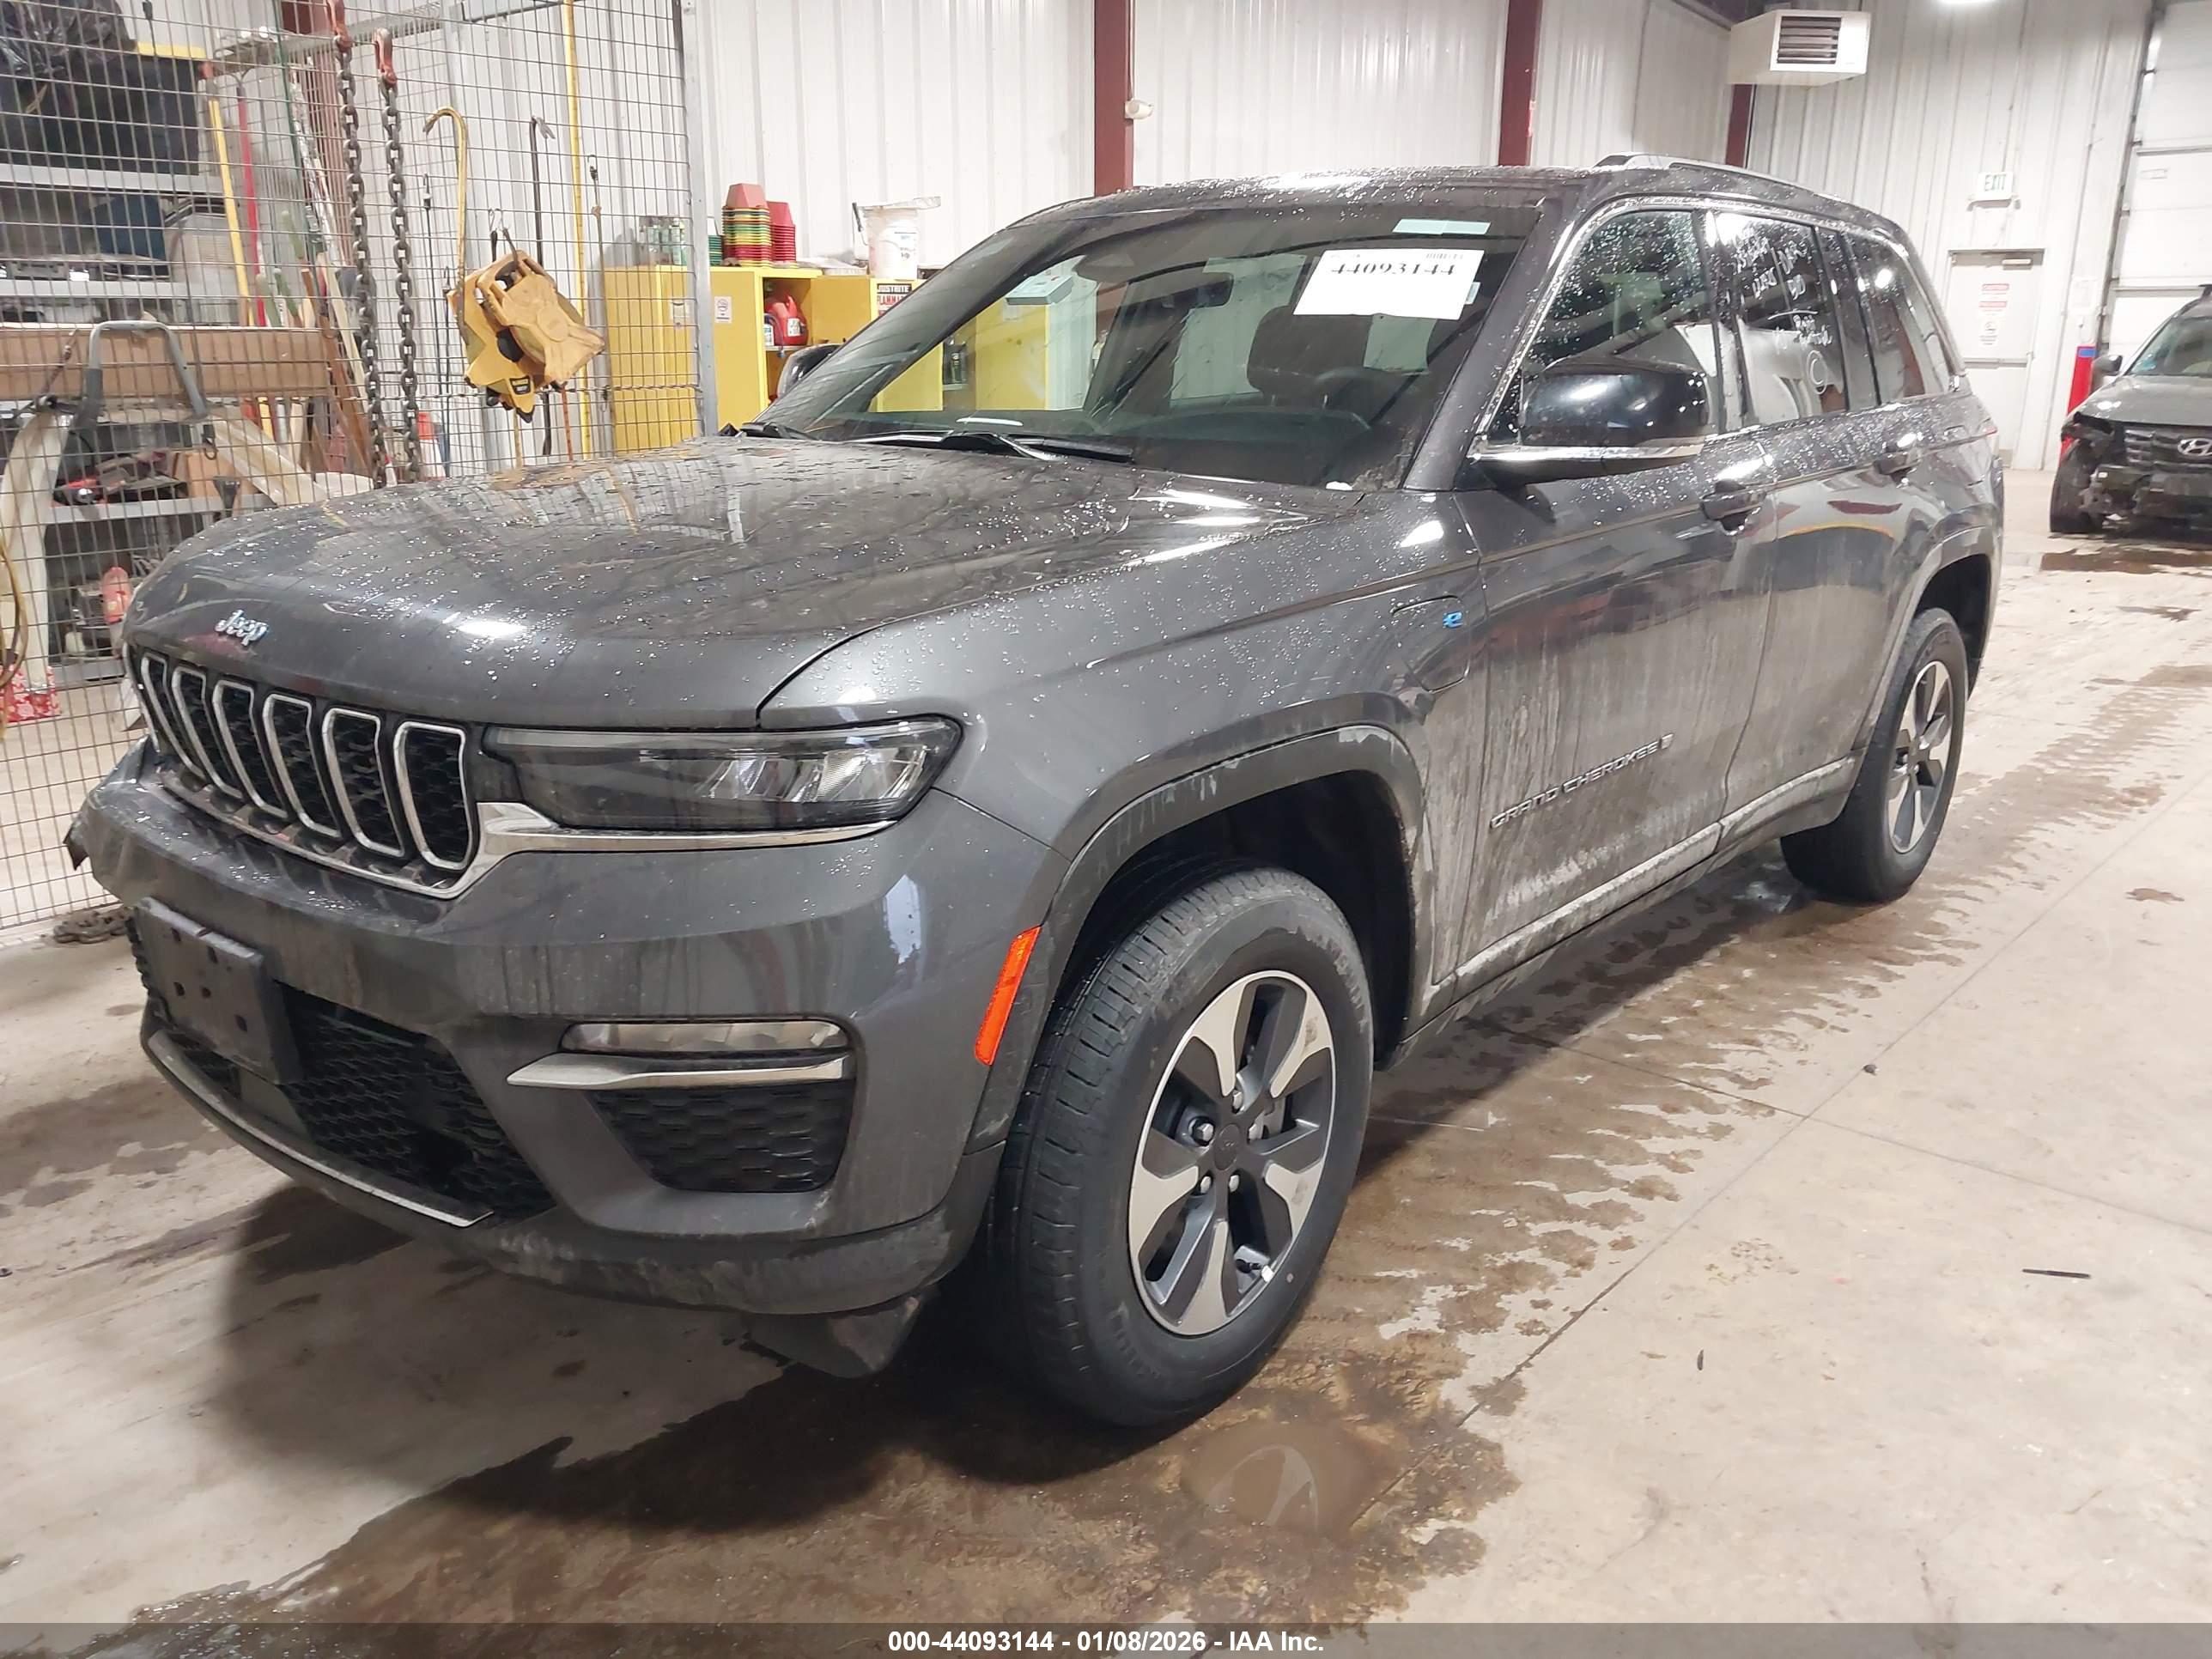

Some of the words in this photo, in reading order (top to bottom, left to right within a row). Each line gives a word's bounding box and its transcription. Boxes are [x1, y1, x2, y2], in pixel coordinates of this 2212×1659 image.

[1984, 173, 2007, 191] EXIT
[1332, 263, 1455, 276] 44093144
[215, 609, 270, 647] Jeep
[1490, 787, 1559, 829] GRAND
[1562, 740, 1659, 793] CHEROKEE
